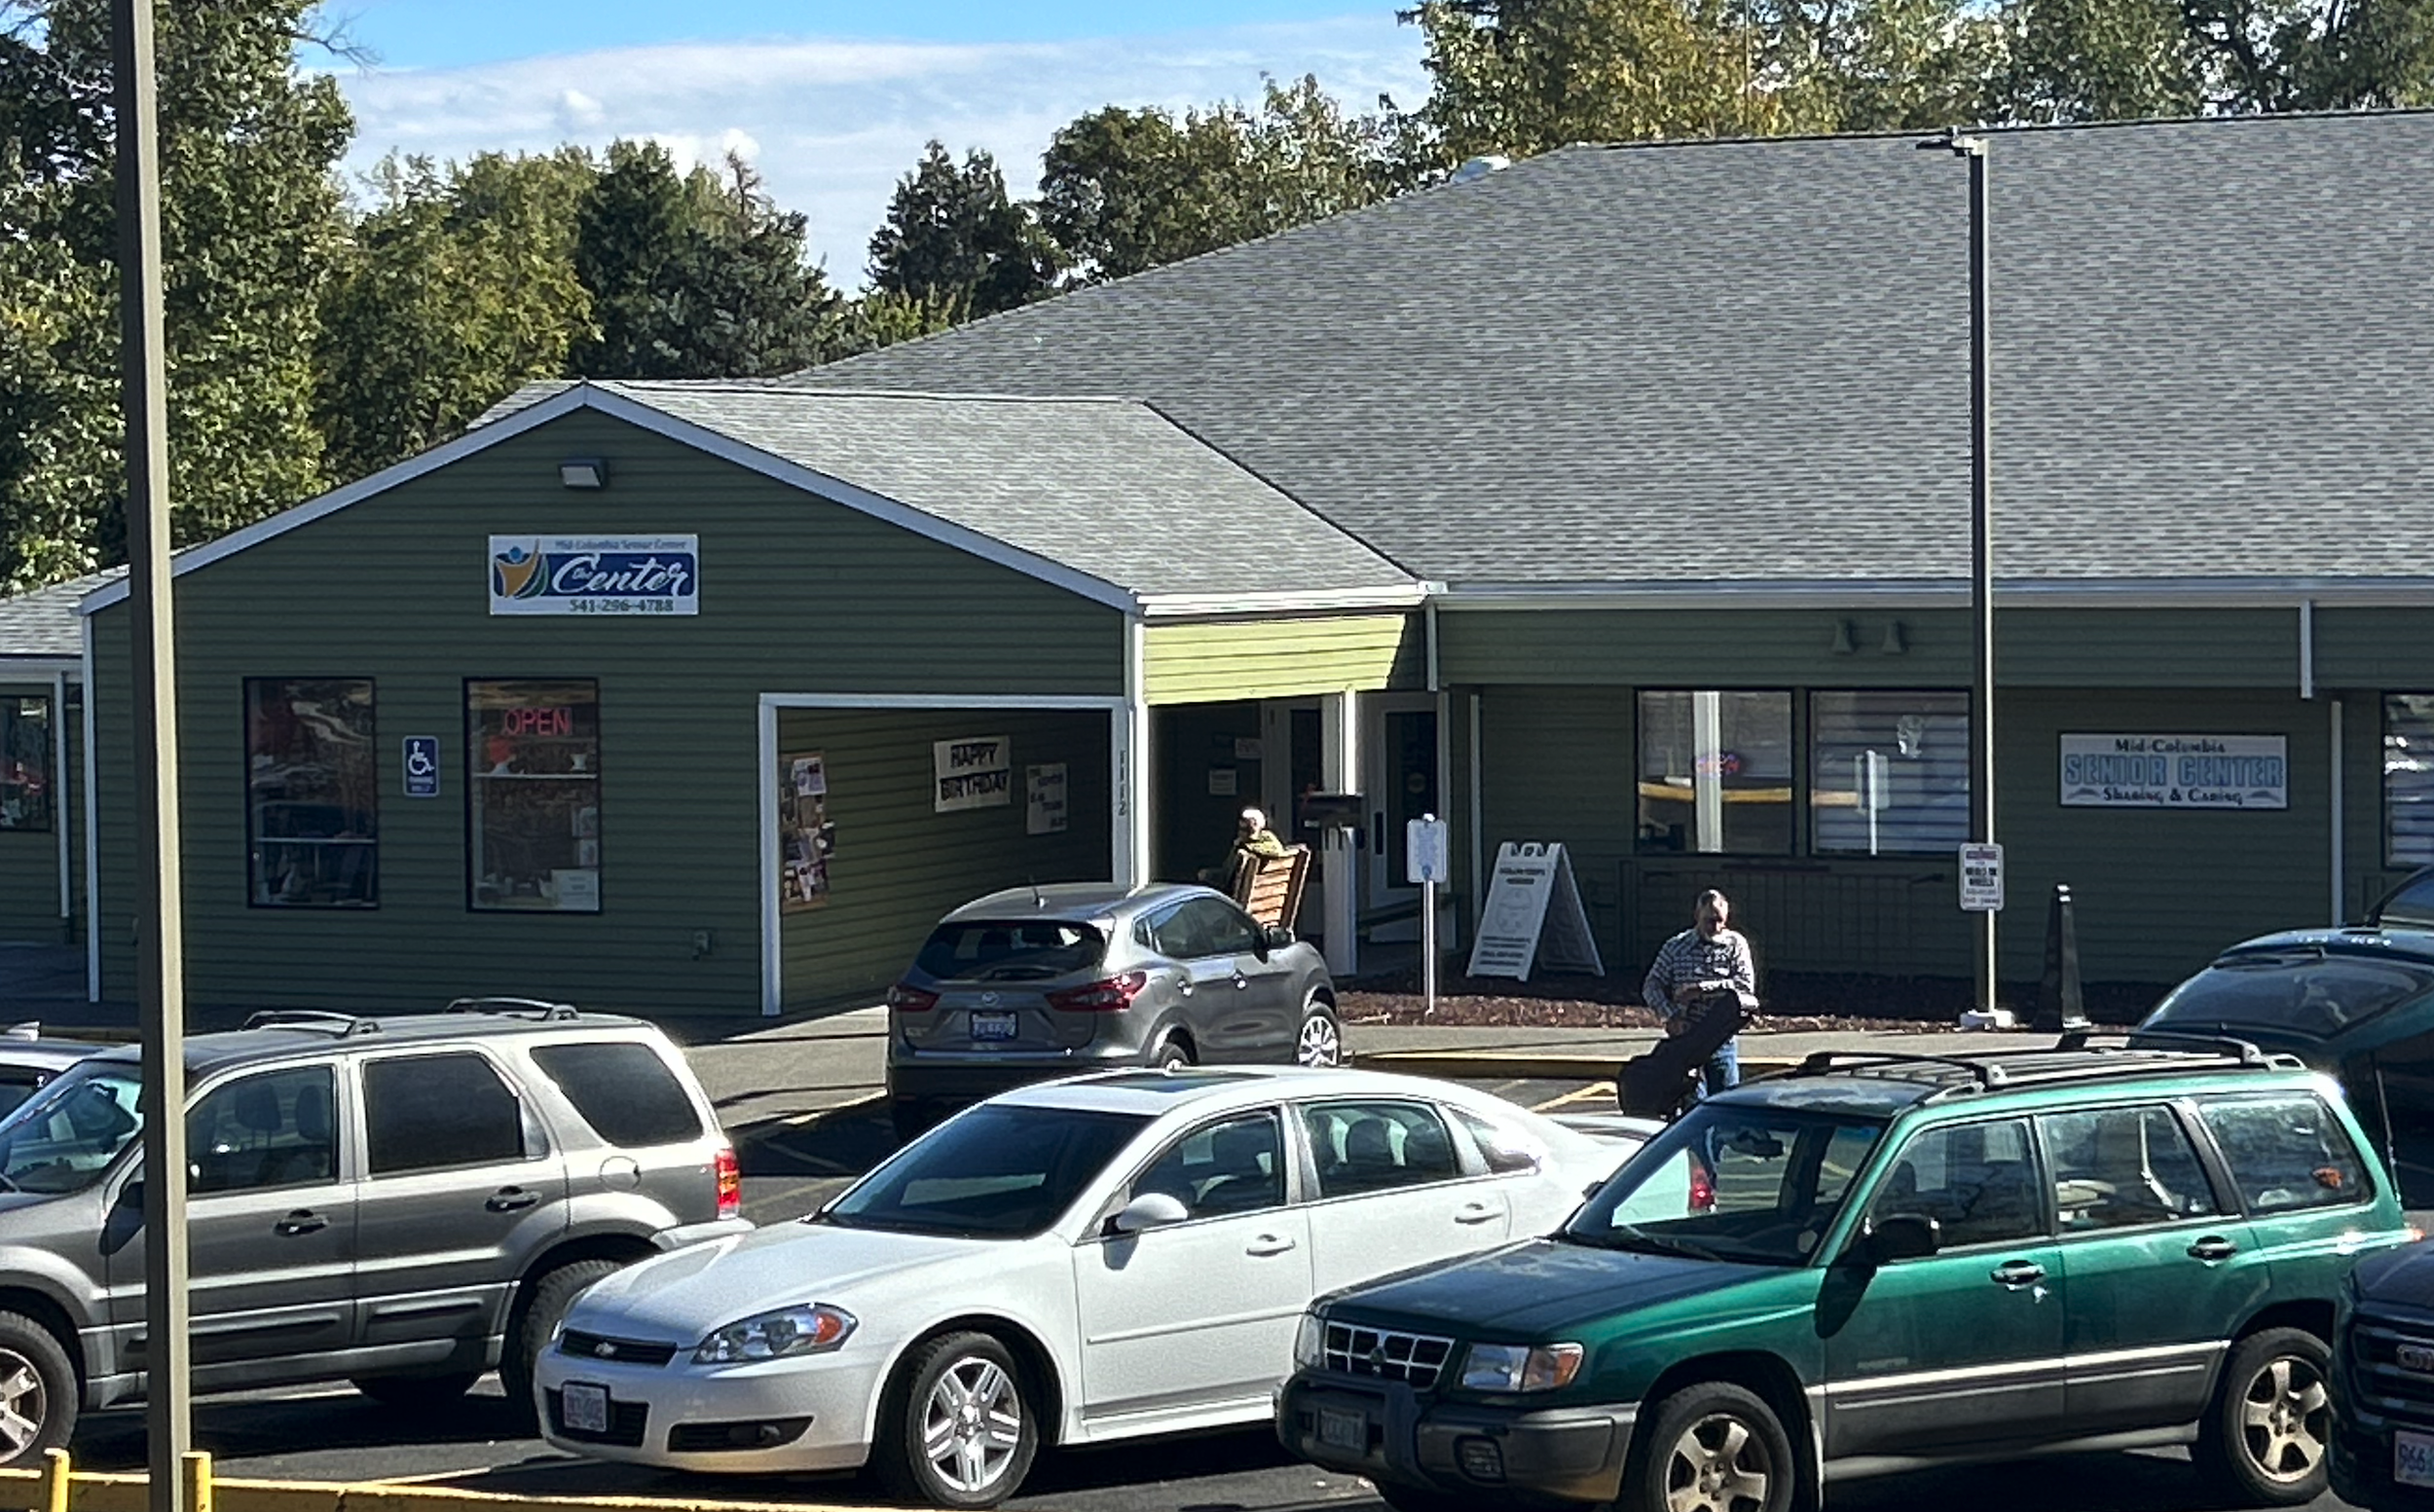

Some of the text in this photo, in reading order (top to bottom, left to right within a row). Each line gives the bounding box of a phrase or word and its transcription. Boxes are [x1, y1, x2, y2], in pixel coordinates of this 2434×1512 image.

[552, 553, 688, 596] Center
[570, 599, 674, 612] 541-296-4788
[503, 707, 572, 736] OPEN
[950, 743, 999, 768] HAPPY
[2114, 738, 2226, 754] Mid-Columbia
[940, 769, 1010, 800] BIRTHDAY
[2064, 754, 2284, 789] SENIOR CENTER
[2103, 788, 2243, 806] Sharing & Caring
